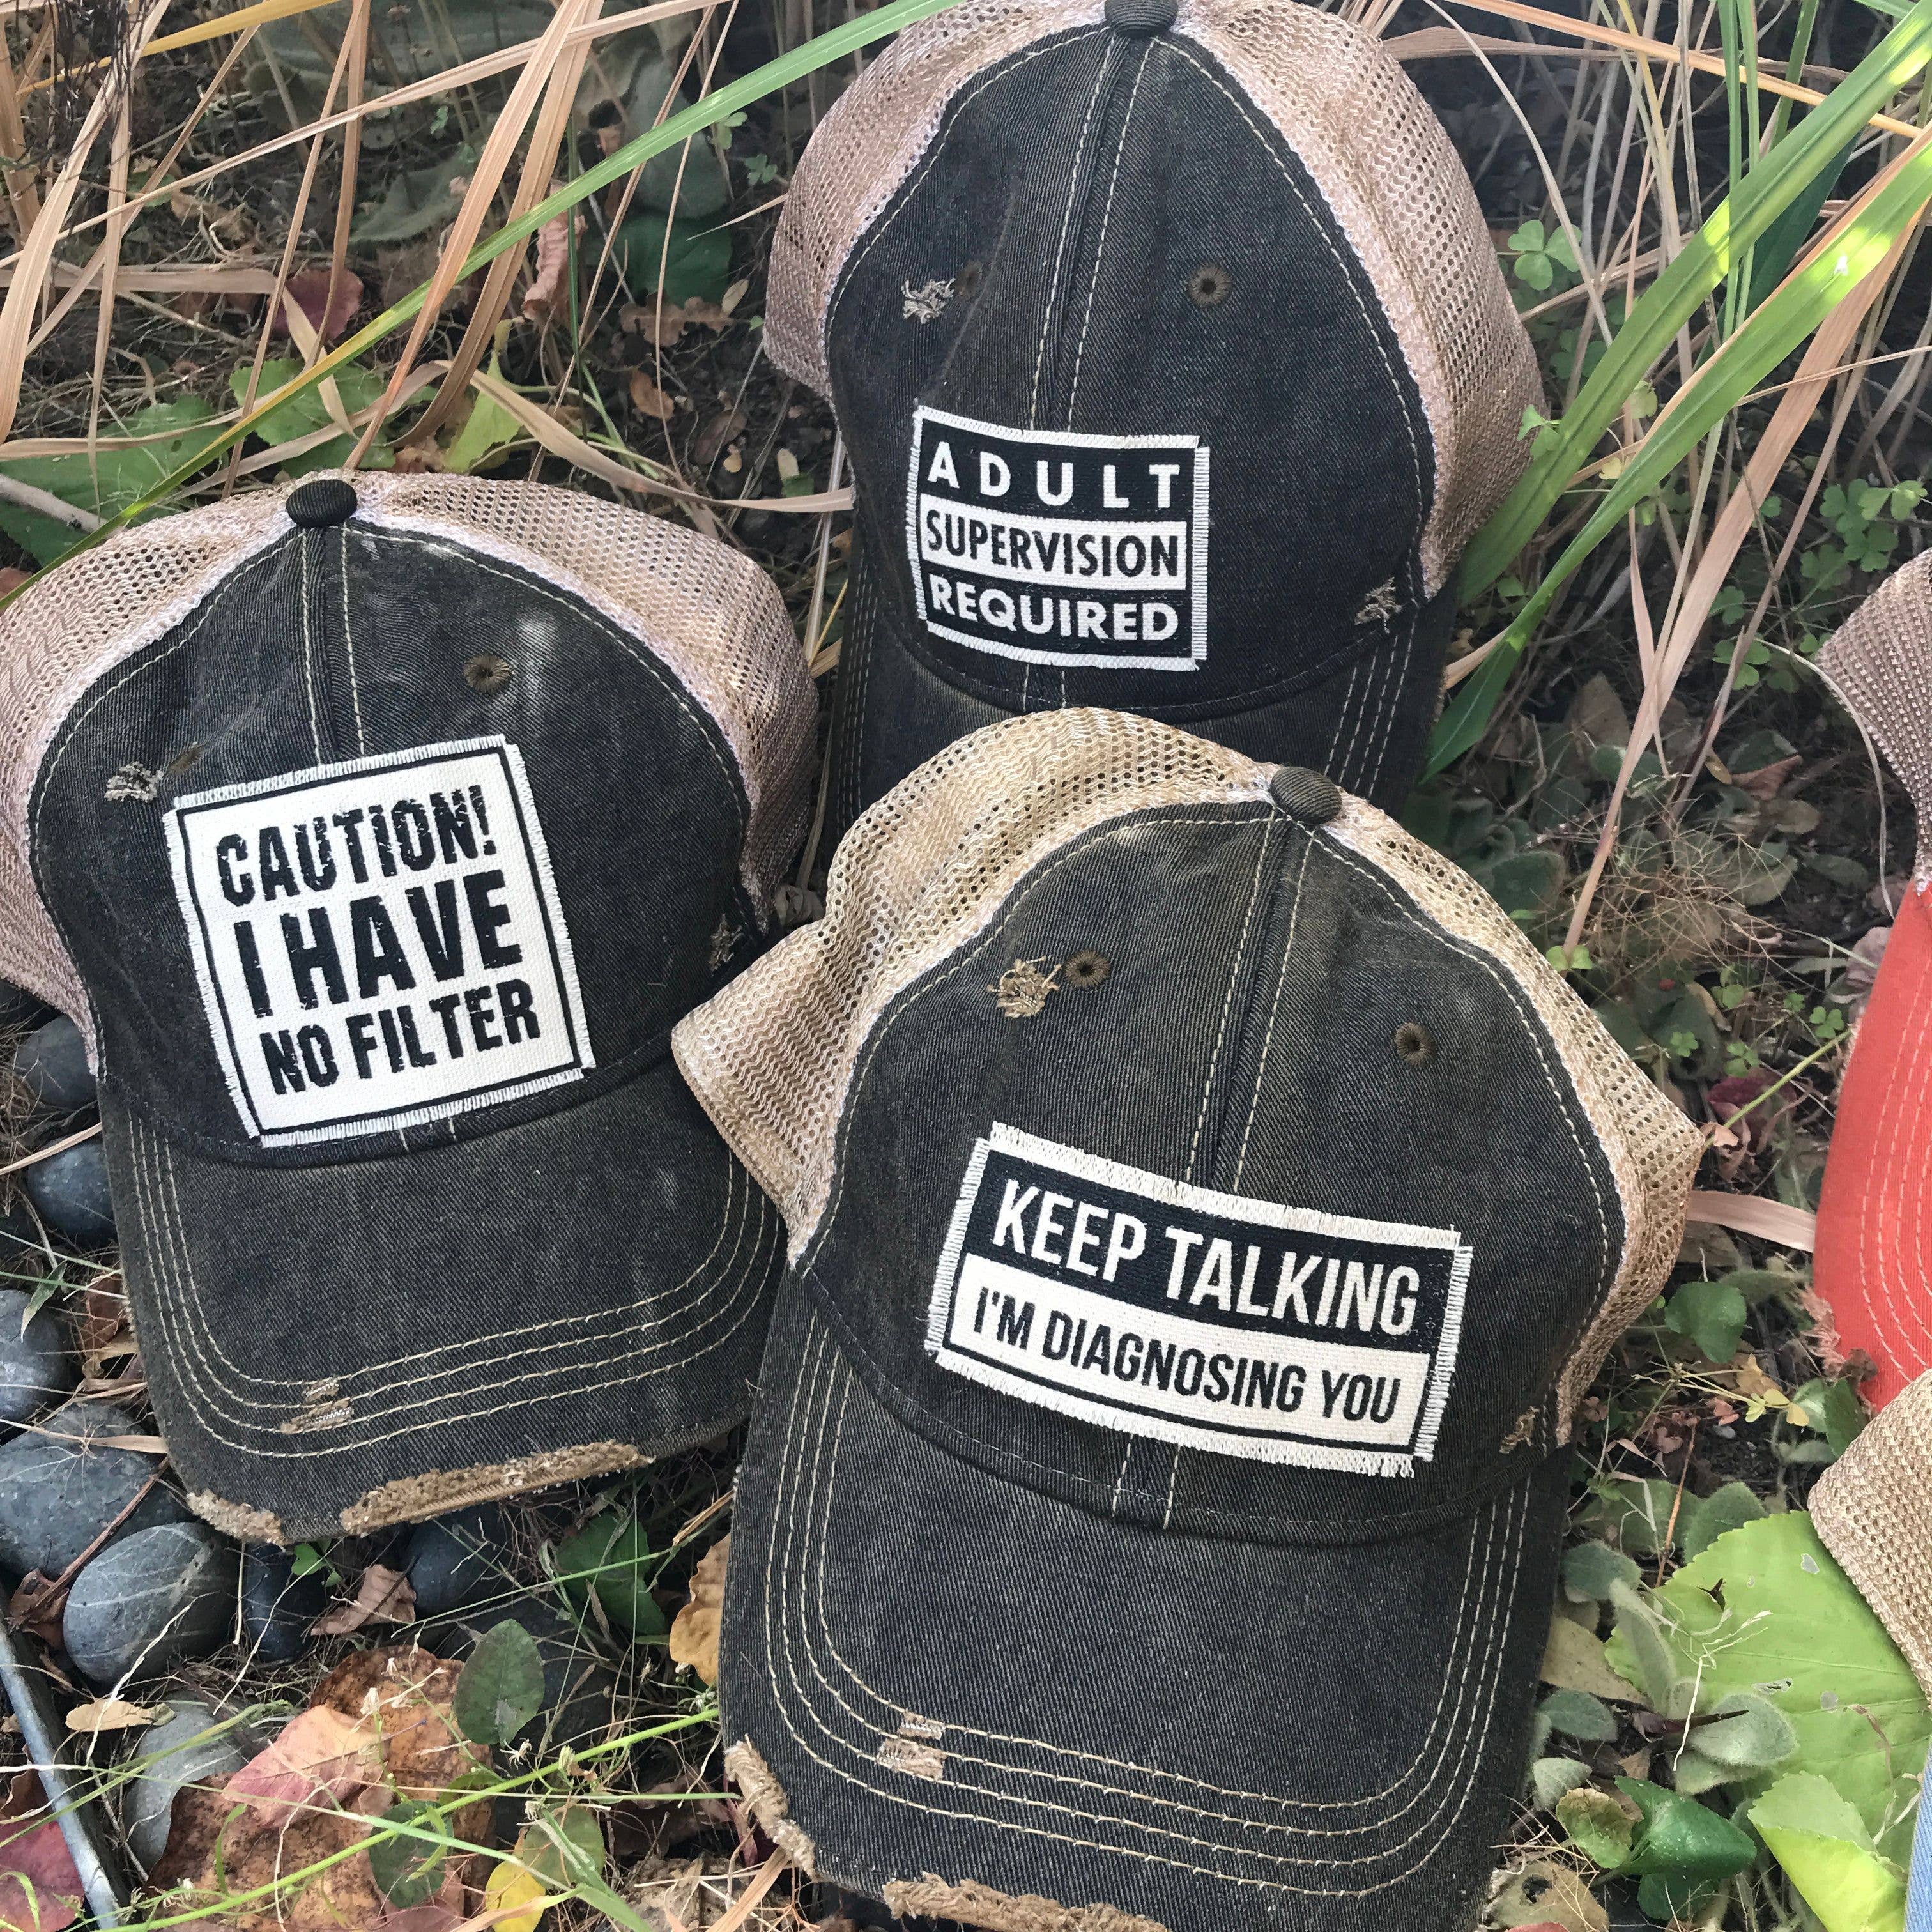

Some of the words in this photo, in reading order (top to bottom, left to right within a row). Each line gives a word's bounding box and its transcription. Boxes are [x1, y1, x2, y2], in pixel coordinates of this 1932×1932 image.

[927, 441, 1180, 508] ADULT
[926, 510, 1177, 577] SUPERVISION
[930, 574, 1178, 640] REQUIRED
[216, 785, 496, 907] CAUTION!
[234, 921, 273, 1018] I
[280, 870, 523, 1011] HAVE
[261, 1023, 339, 1094] NO
[346, 979, 540, 1079] FILTER
[992, 1179, 1146, 1280] KEEP
[1165, 1225, 1420, 1336] TALKING
[974, 1286, 1035, 1350] I'M
[1042, 1310, 1306, 1413] DIAGNOSING
[1321, 1369, 1400, 1423] YOU
